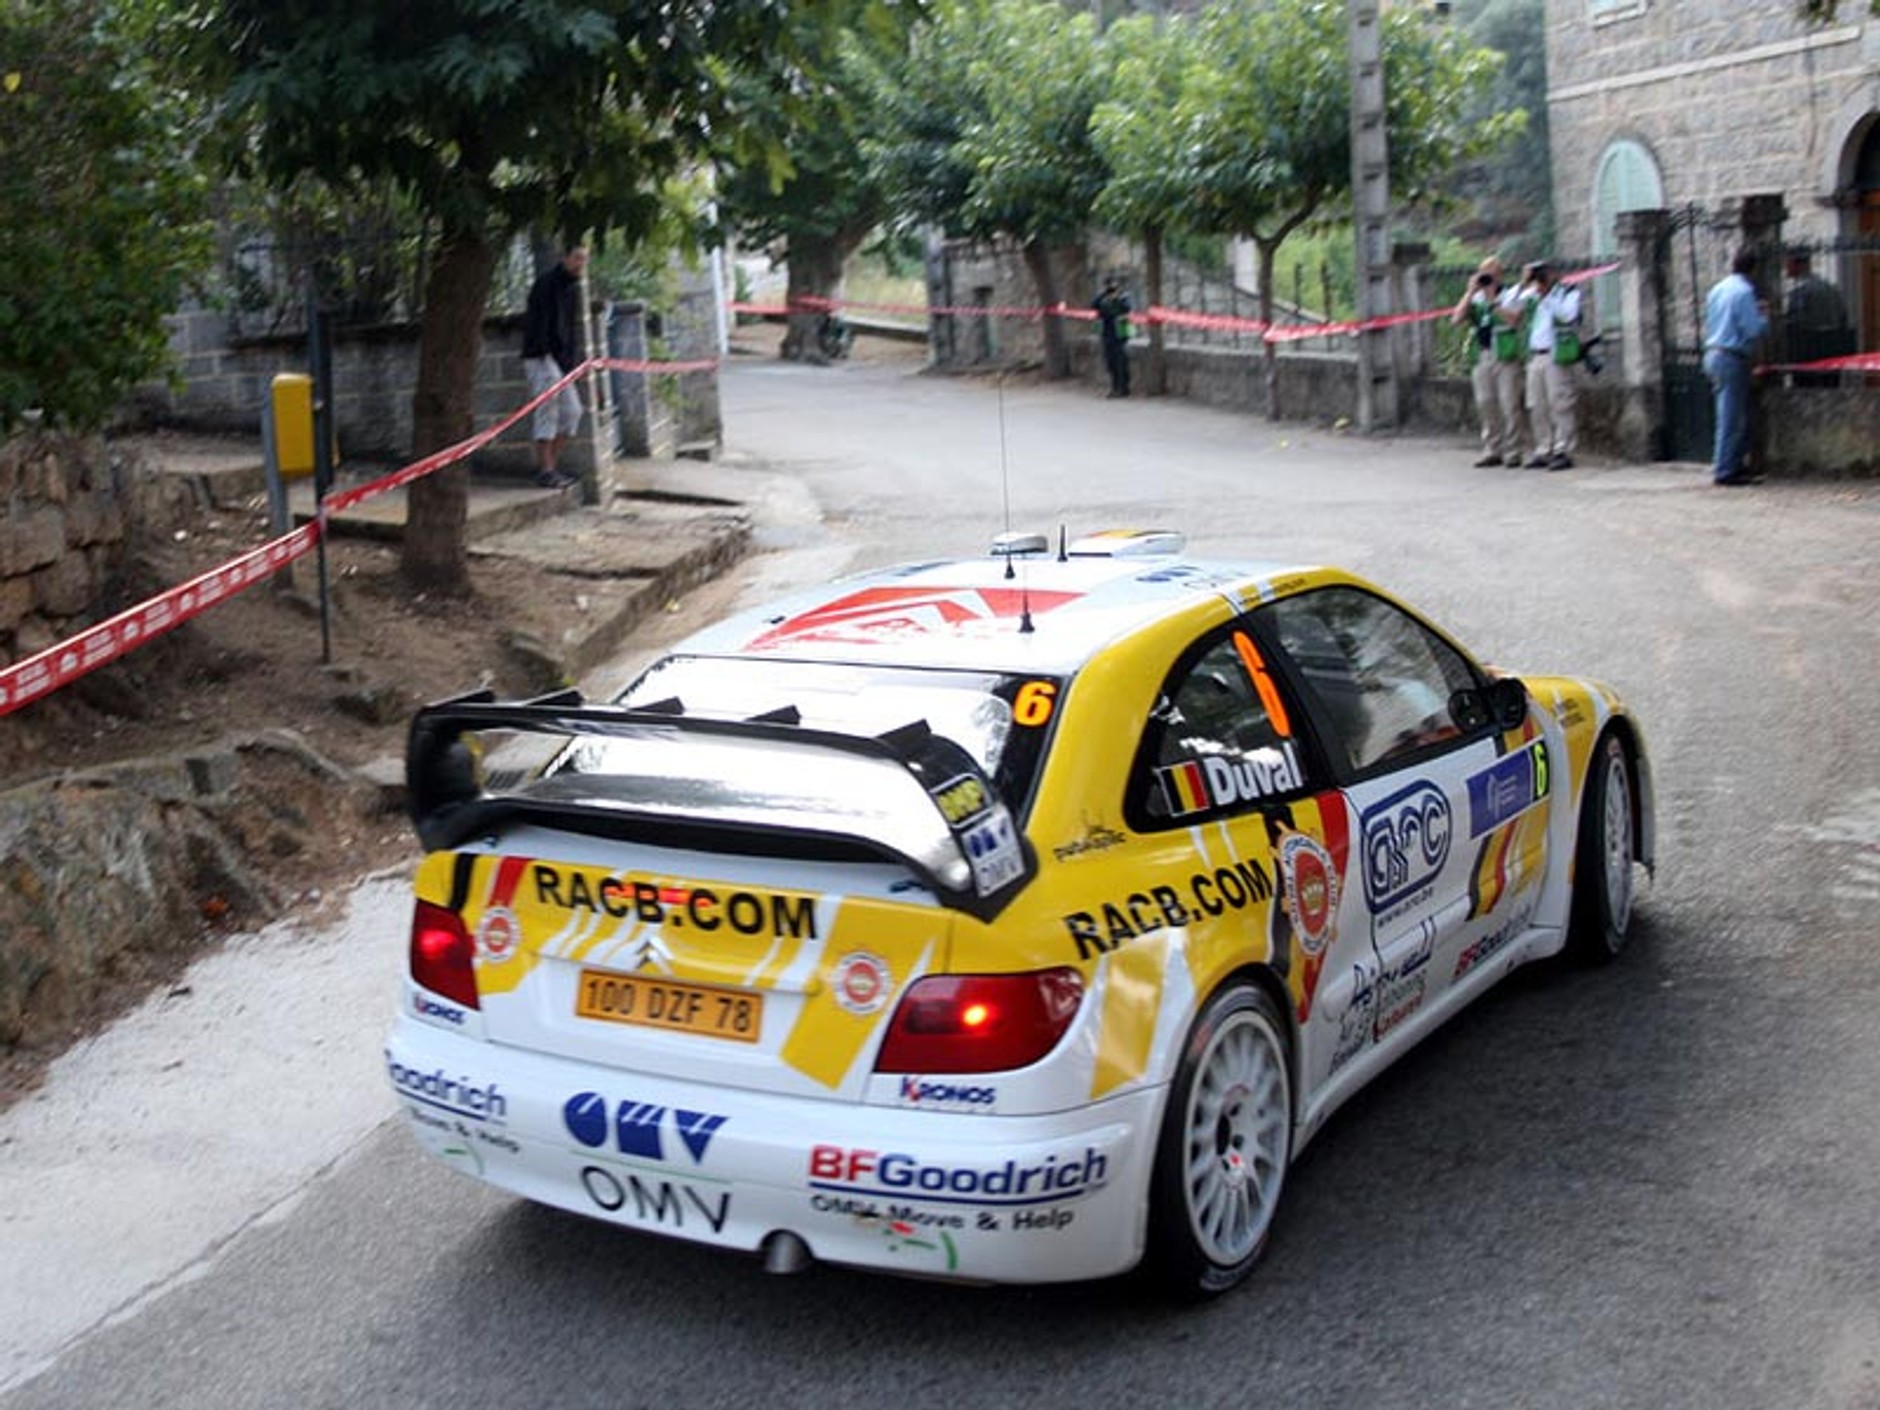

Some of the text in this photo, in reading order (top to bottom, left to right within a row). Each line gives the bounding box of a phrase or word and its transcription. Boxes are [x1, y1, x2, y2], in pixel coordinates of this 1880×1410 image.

[1014, 680, 1056, 727] 6
[1233, 629, 1291, 738] 6
[1203, 740, 1303, 806] Duval
[1533, 742, 1547, 798] 6
[533, 865, 818, 940] RACB.COM
[1064, 858, 1274, 960] RACB.COM
[586, 979, 751, 1033] 100 DZF 78
[384, 1048, 507, 1116] oodrich
[580, 1165, 731, 1234] OMV
[807, 1145, 1109, 1194] BFGoodrich
[1013, 1208, 1075, 1232] Help
